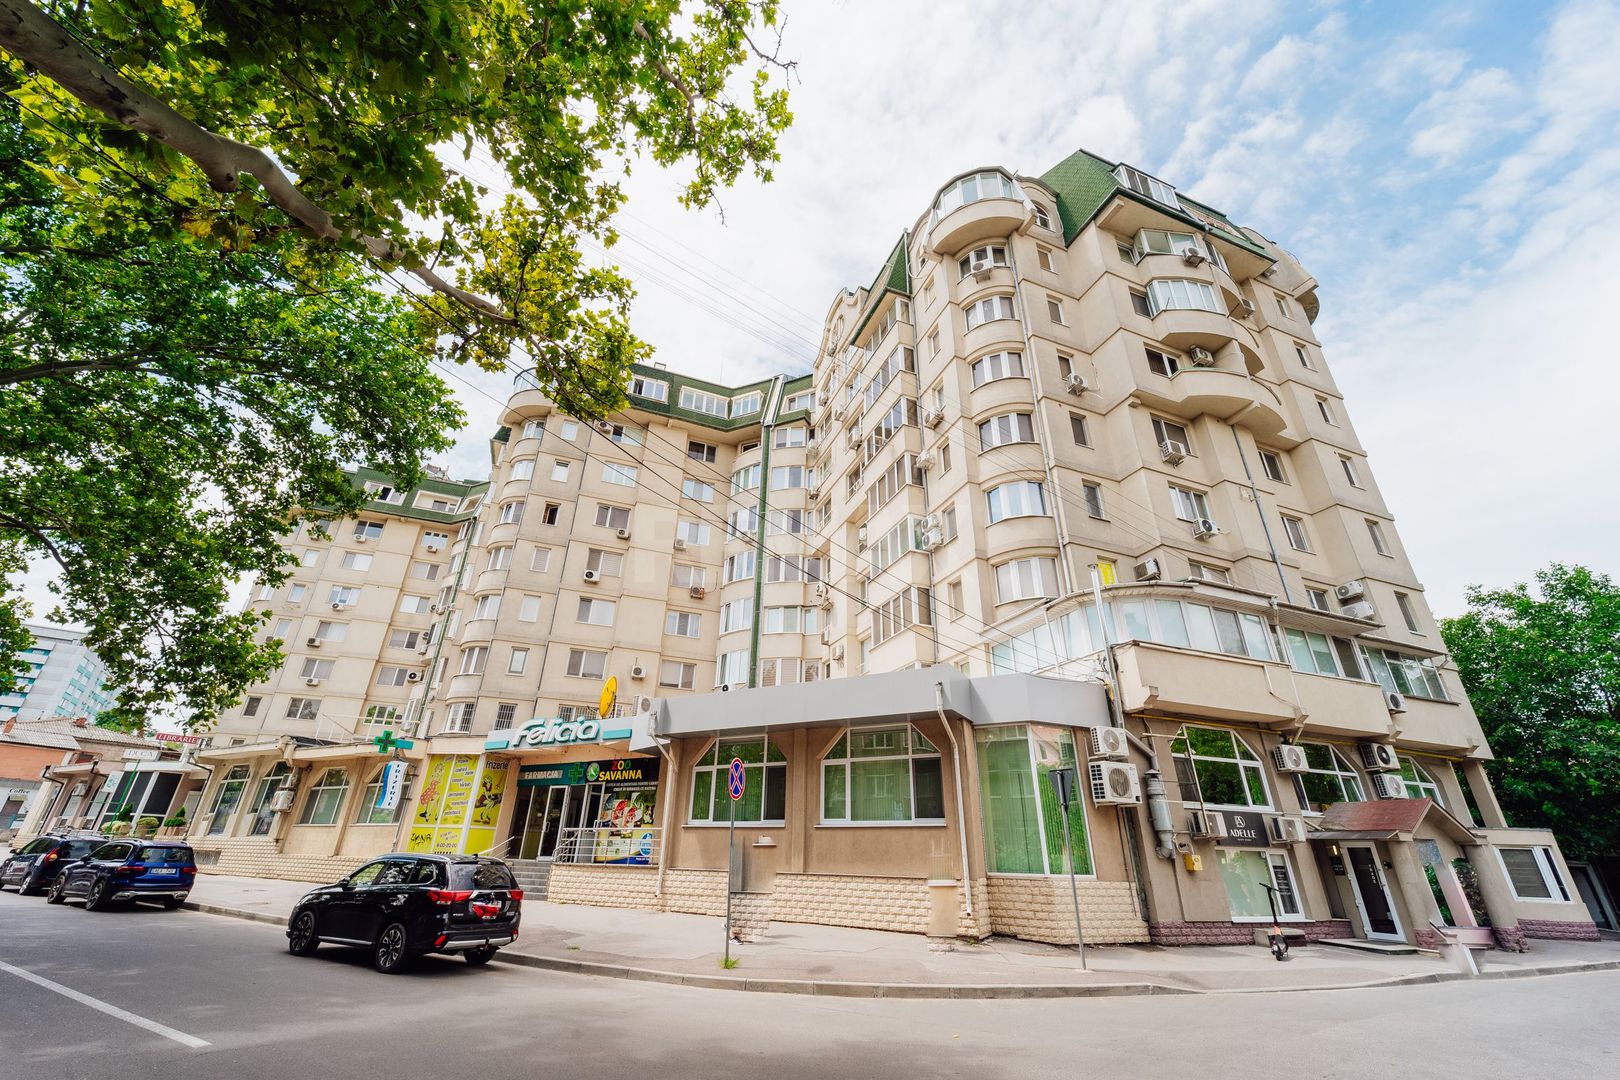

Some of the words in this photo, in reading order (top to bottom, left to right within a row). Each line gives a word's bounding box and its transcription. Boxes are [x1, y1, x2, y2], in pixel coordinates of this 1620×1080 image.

[512, 716, 601, 748] Felicia
[611, 760, 631, 771] ZOO
[524, 770, 559, 780] FARMACIA
[598, 769, 643, 781] SAVANNA
[1230, 829, 1257, 838] ADELLE
